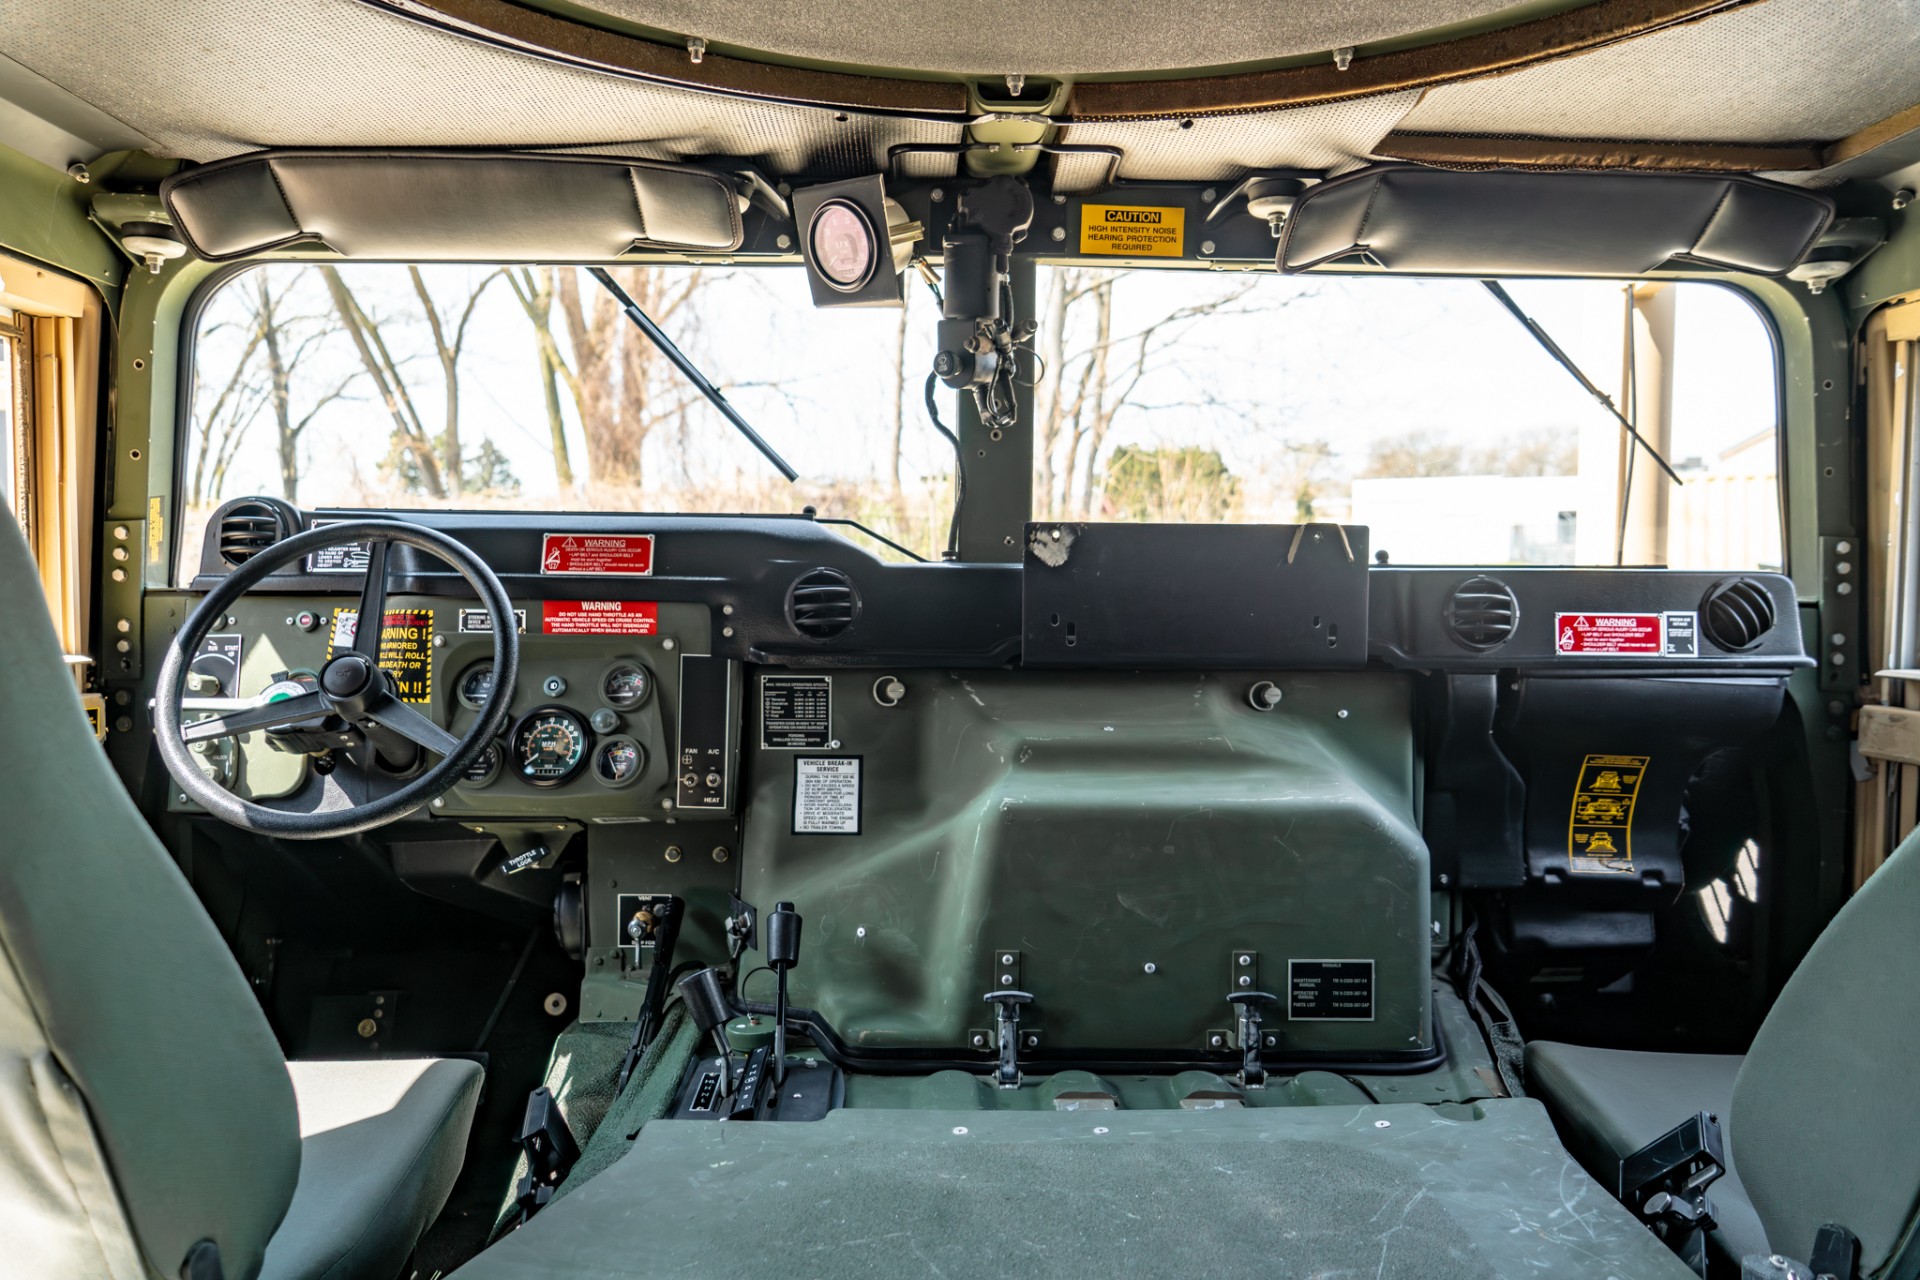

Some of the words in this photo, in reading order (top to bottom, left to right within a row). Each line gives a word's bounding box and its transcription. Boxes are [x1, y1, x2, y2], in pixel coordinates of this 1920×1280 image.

[1107, 211, 1159, 222] CAUTION
[1110, 226, 1150, 234] INTENSITY
[1126, 235, 1176, 243] PROTECTION
[1112, 243, 1152, 251] REQUIRED
[584, 538, 626, 547] WARNING
[582, 601, 622, 611] WARNING
[1595, 618, 1636, 626] WARNING
[382, 628, 418, 640] ARNING
[422, 628, 426, 640] !
[508, 849, 537, 866] THROTTLE
[517, 858, 532, 868] LOCK
